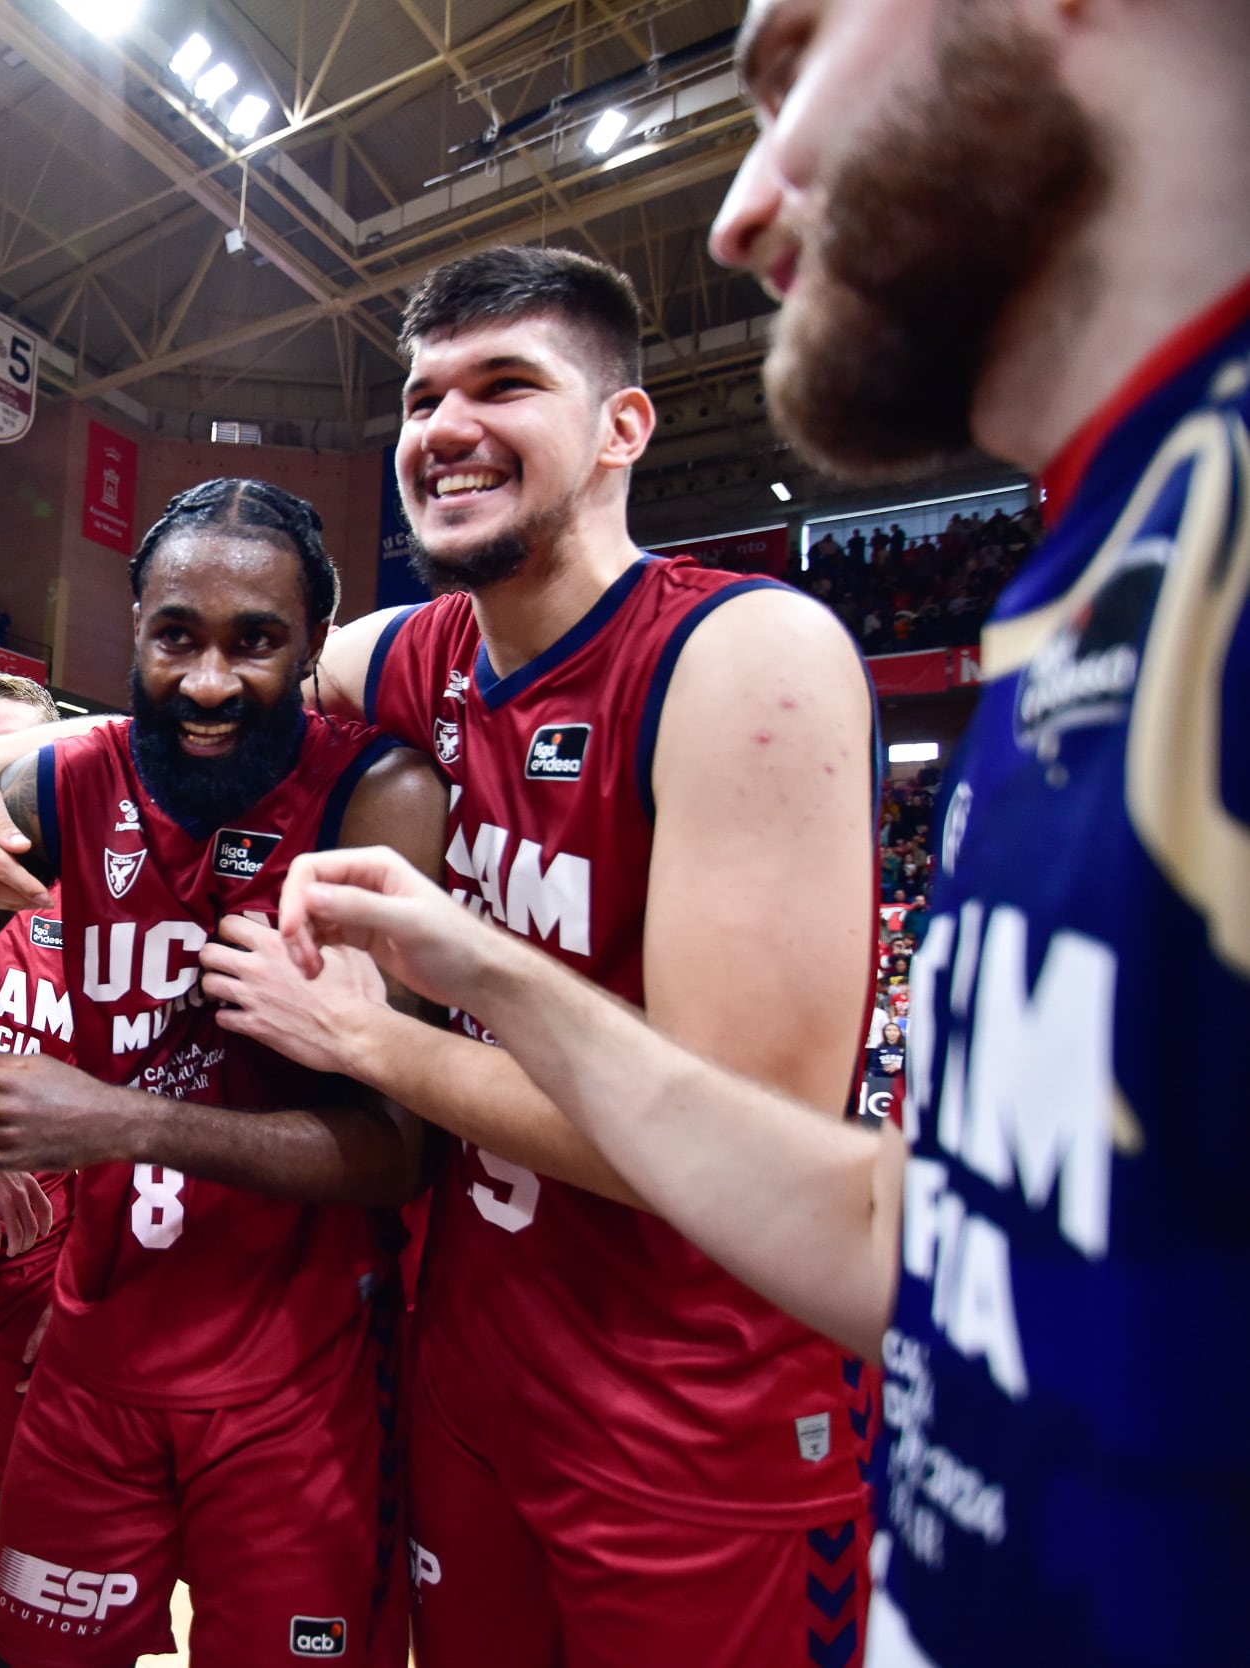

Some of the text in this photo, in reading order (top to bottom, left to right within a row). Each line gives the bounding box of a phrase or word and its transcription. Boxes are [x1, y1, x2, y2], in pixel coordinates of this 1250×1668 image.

[8, 336, 31, 384] 5
[533, 741, 558, 759] liga
[531, 758, 582, 772] endesa
[221, 843, 248, 859] liga
[219, 857, 265, 873] endes
[33, 925, 49, 935] liga
[131, 1164, 184, 1249] 8
[18, 1556, 139, 1621] ESP
[296, 1633, 335, 1652] acb
